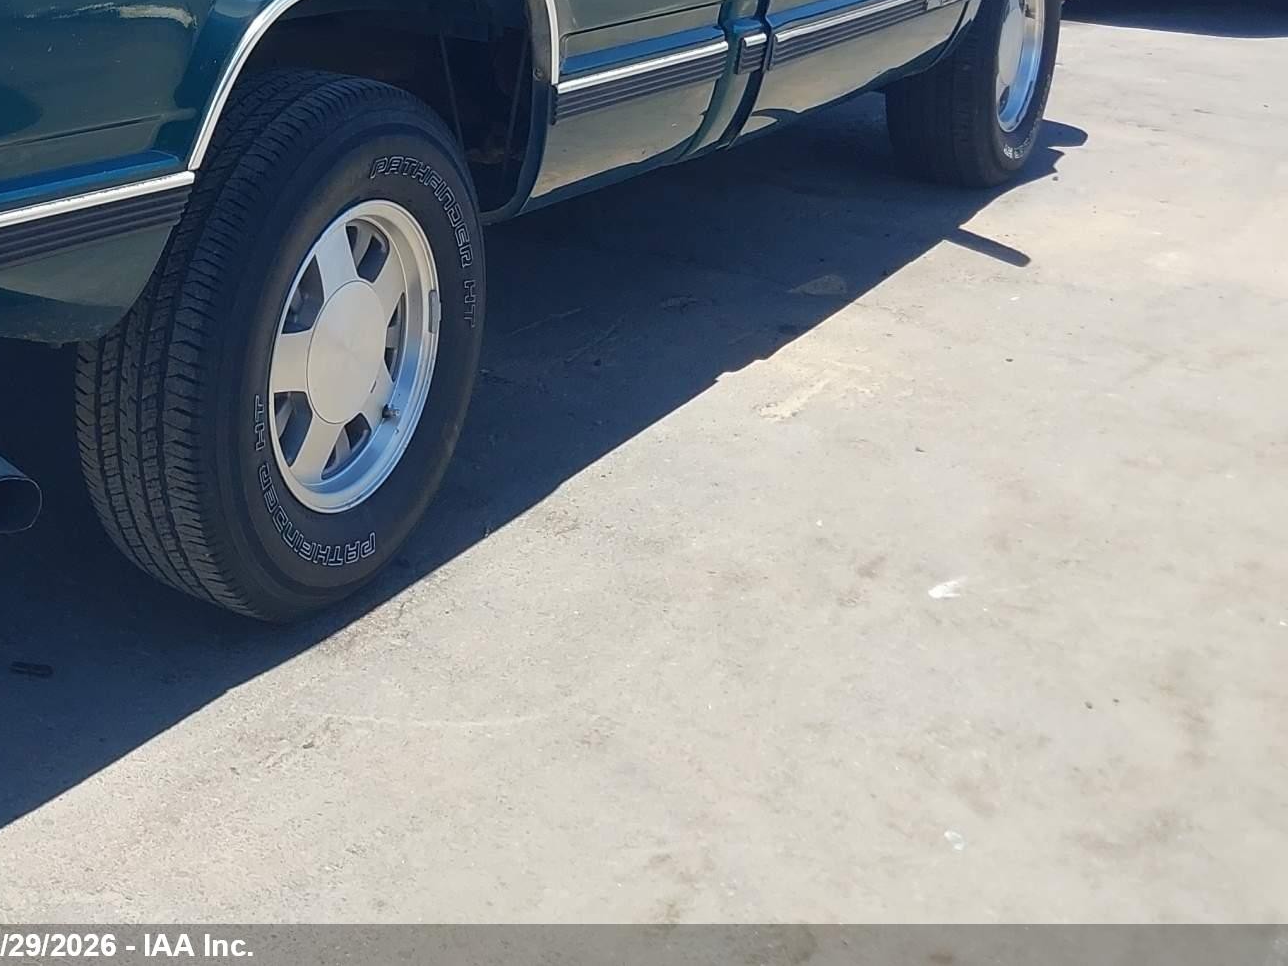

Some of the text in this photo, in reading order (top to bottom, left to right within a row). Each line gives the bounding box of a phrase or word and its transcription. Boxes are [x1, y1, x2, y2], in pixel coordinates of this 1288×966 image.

[369, 156, 477, 328] PATHFINDER HT
[254, 394, 377, 567] PATHFINDER HT
